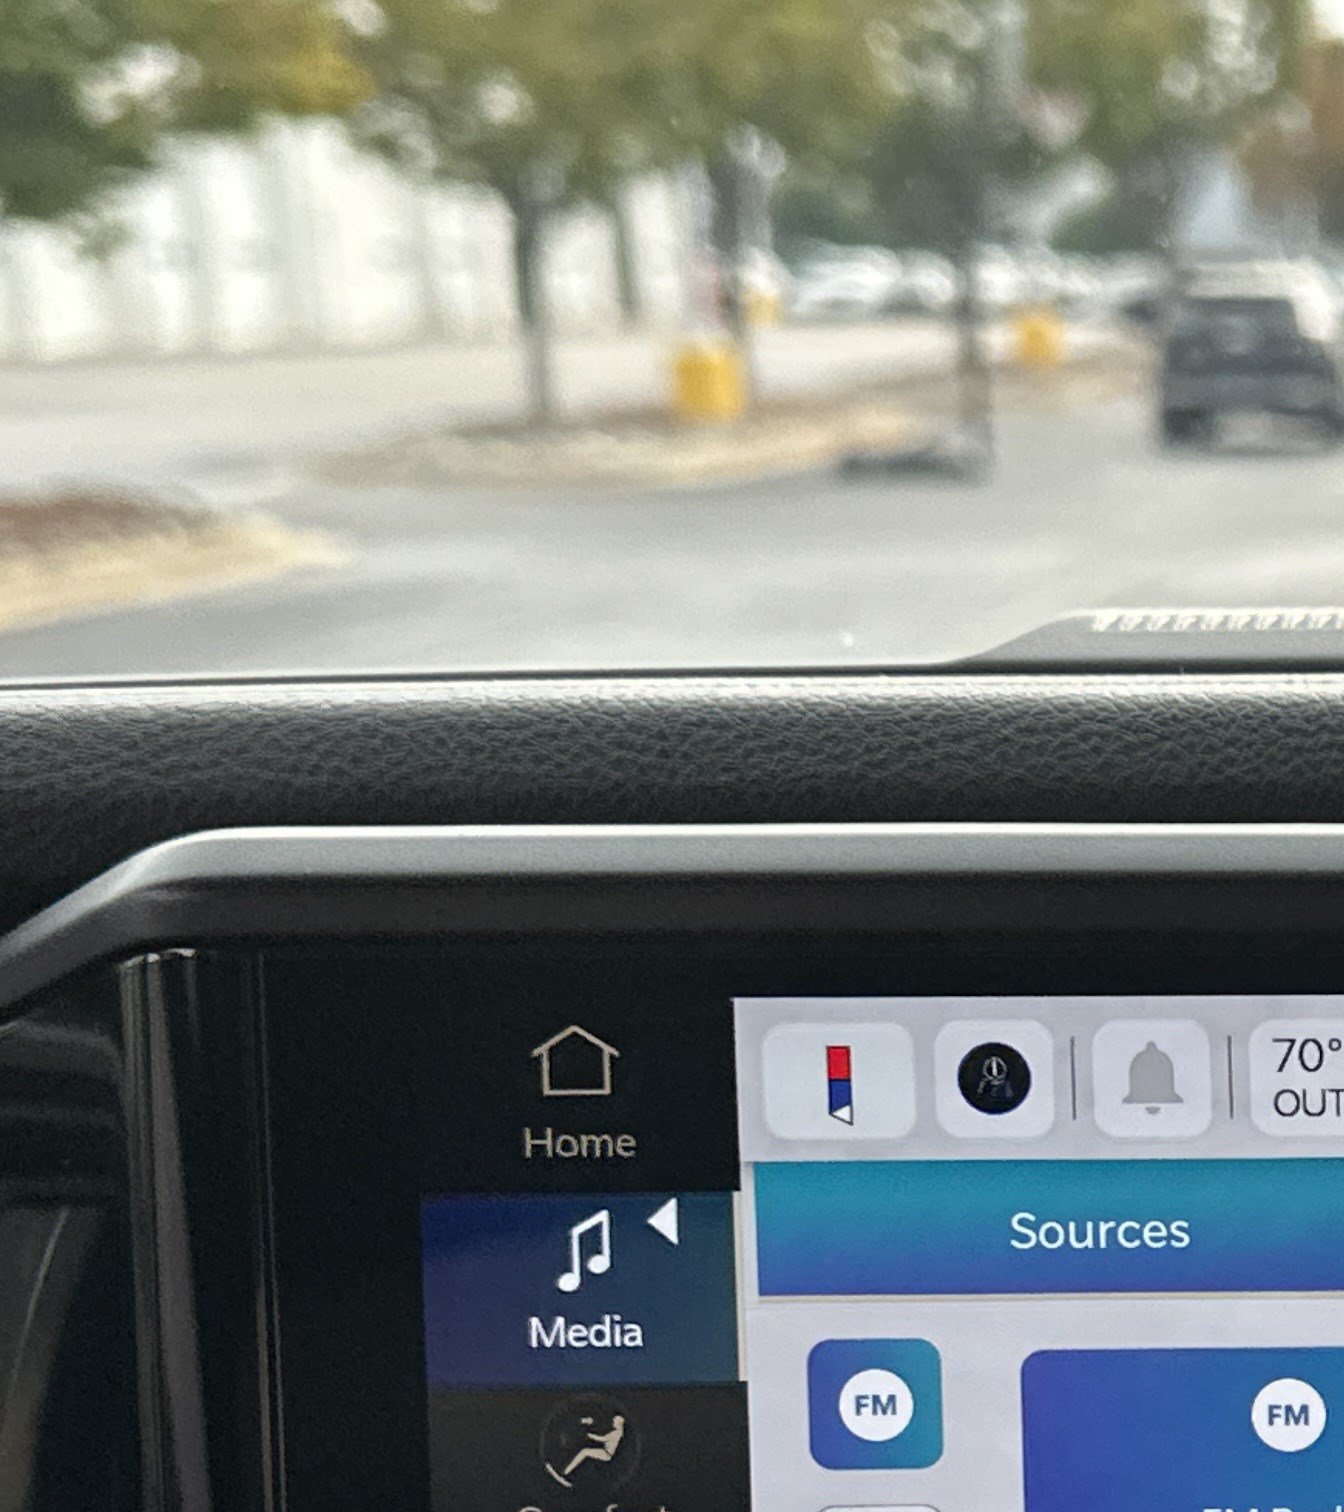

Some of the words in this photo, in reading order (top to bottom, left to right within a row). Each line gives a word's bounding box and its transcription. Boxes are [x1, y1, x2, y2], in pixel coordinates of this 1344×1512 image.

[1271, 1037, 1343, 1073] 70°
[523, 1127, 637, 1159] Home
[1009, 1212, 1191, 1251] Sources
[528, 1316, 644, 1348] Media
[854, 1394, 897, 1417] FM
[1267, 1405, 1310, 1426] FM
